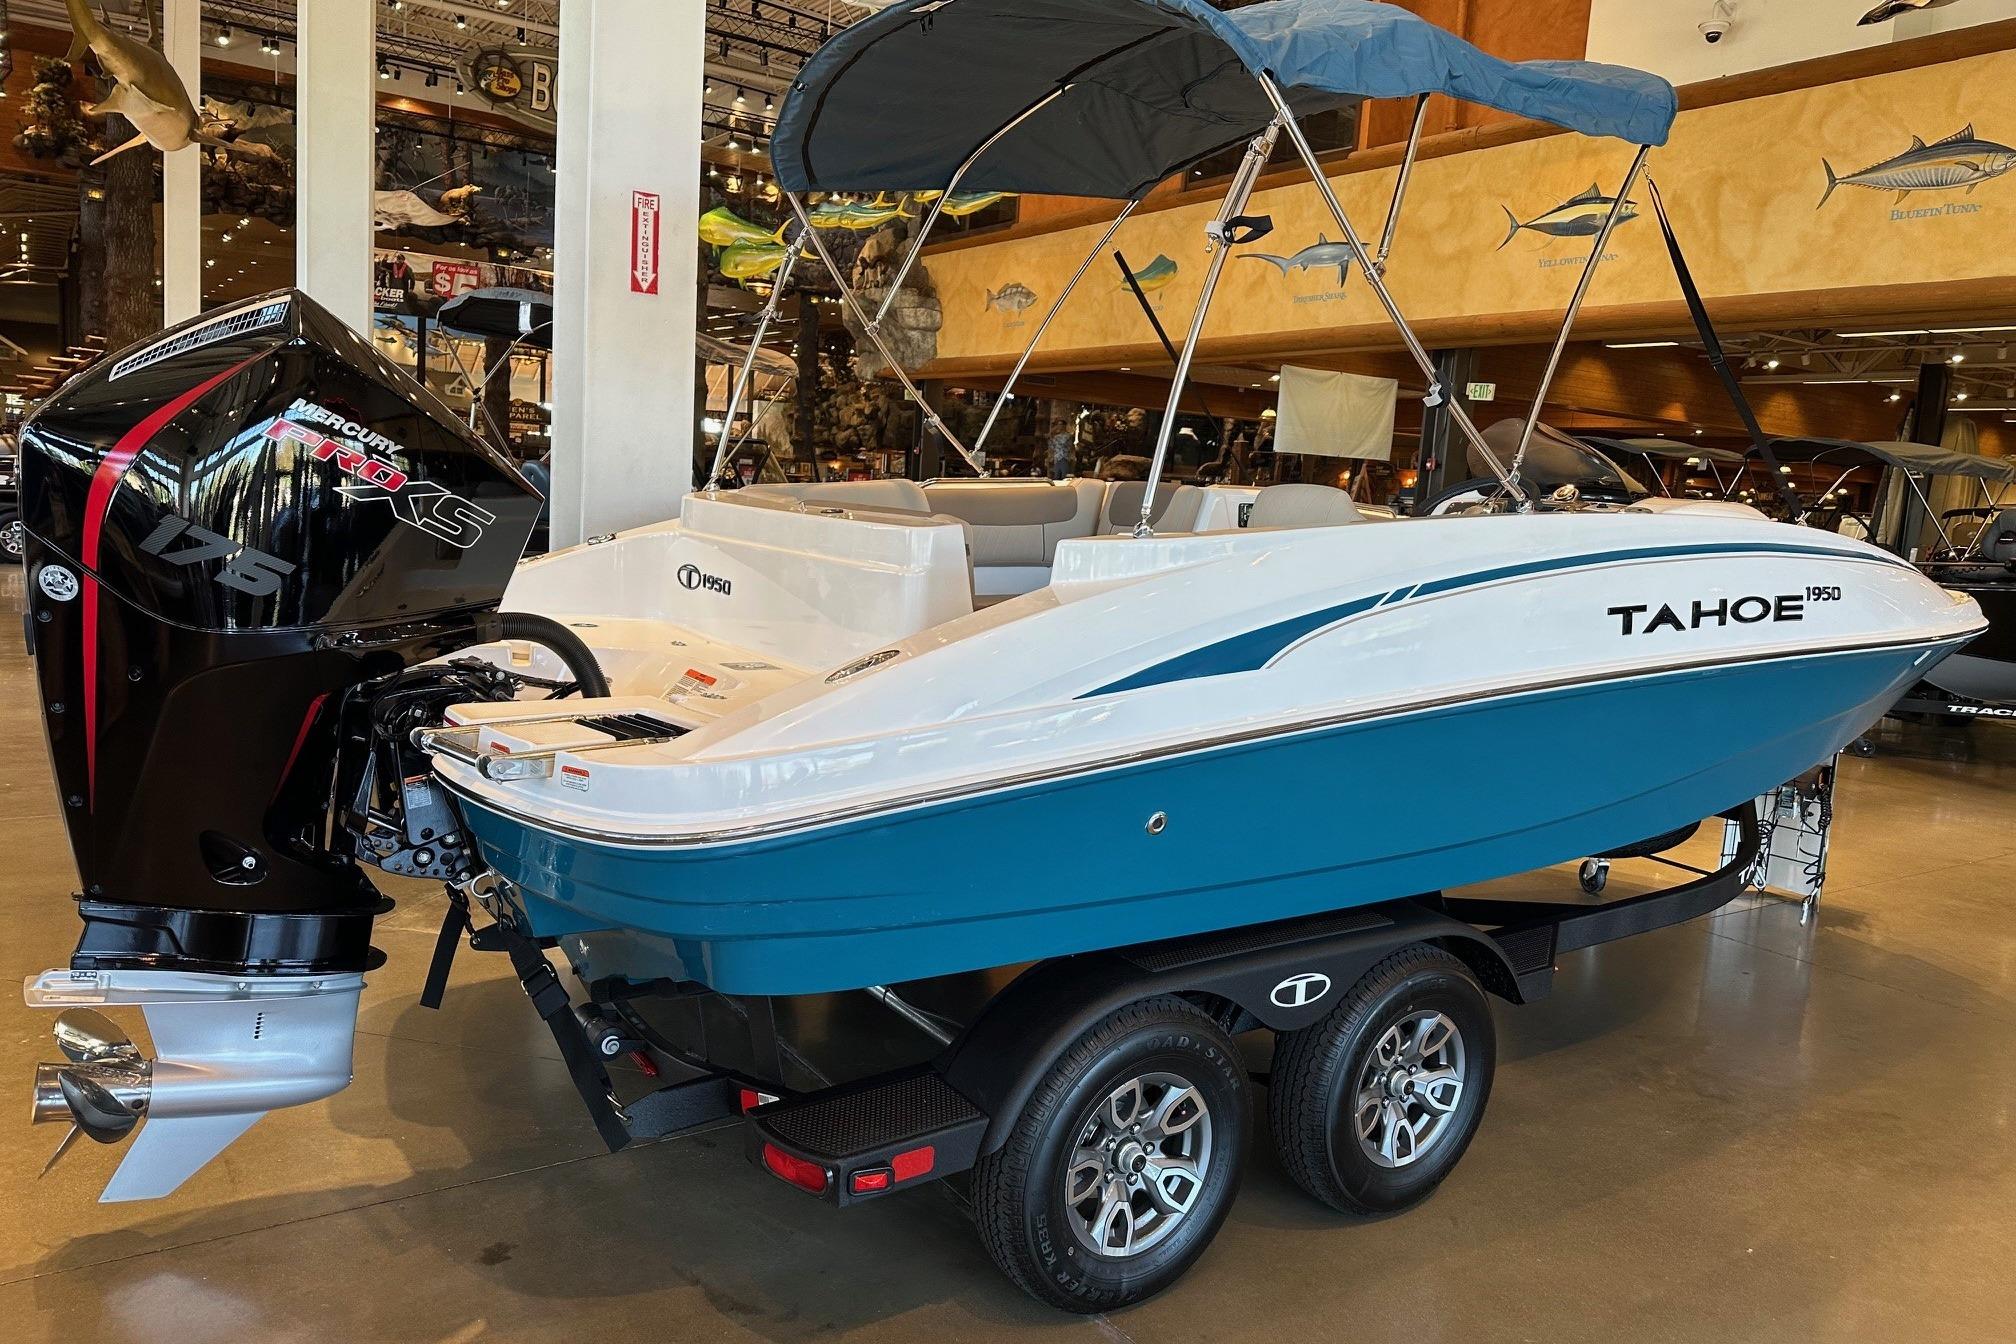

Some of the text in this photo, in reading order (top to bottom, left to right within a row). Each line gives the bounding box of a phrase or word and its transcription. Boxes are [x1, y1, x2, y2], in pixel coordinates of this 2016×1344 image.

[638, 197, 655, 210] FIRE
[1890, 203, 1978, 221] BLUEFIN TUNA
[641, 211, 649, 283] EXTINGUISHER
[1473, 384, 1490, 399] EXIT
[511, 406, 535, 414] EN'S
[289, 398, 404, 455] MERCURY
[262, 417, 408, 493] PRO
[138, 513, 297, 597] 175
[702, 573, 732, 596] 1950
[1607, 586, 1842, 636] TAHOE 1950
[1947, 704, 2016, 717] TRAC
